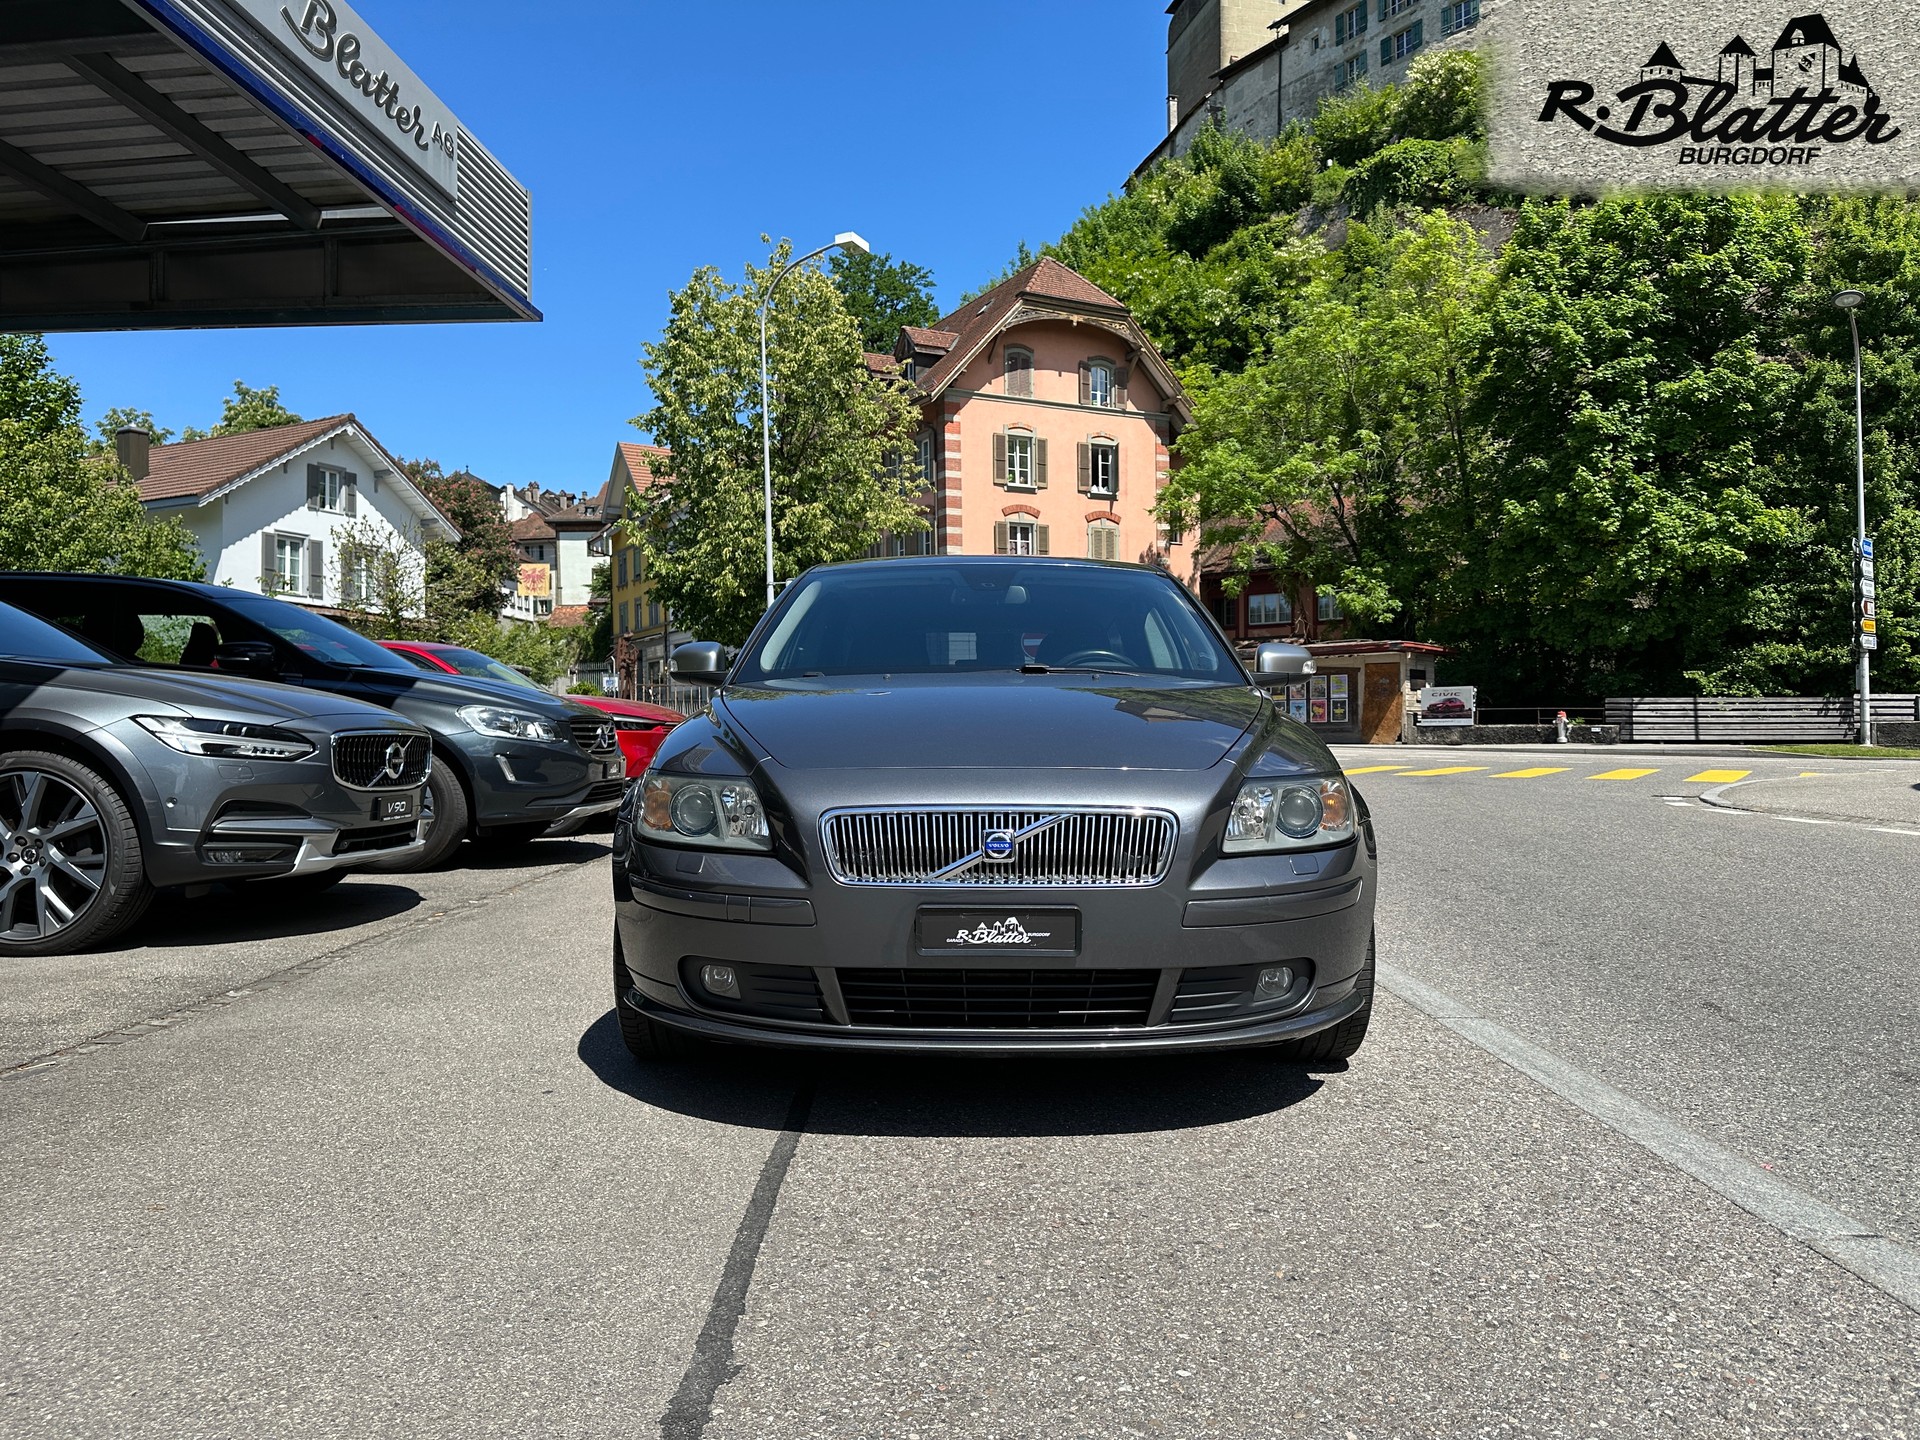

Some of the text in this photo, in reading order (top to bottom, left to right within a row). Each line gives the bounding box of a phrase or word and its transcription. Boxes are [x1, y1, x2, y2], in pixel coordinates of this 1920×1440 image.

[280, 0, 455, 161] Blatter AG
[387, 800, 407, 814] V90
